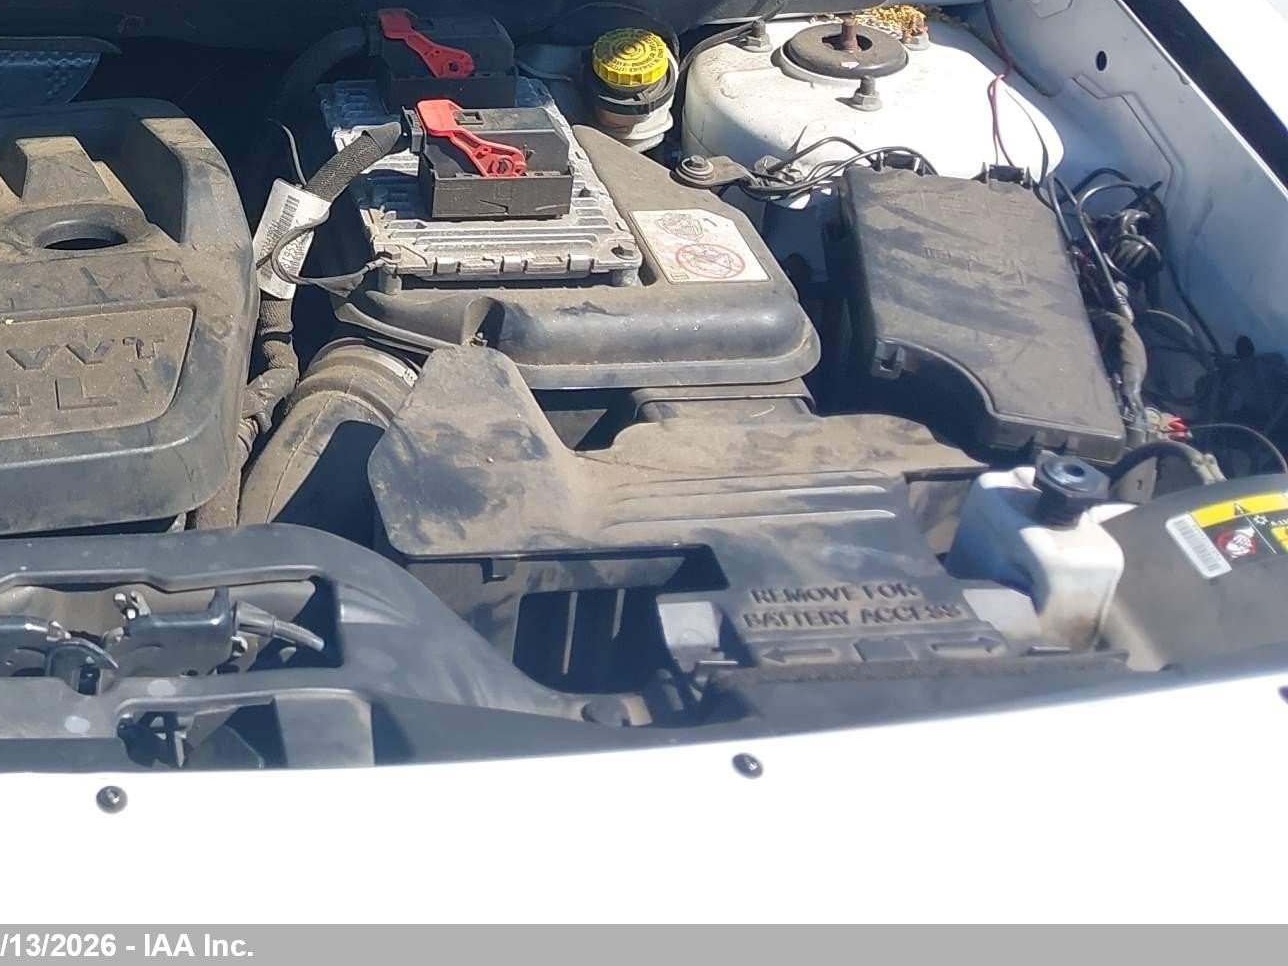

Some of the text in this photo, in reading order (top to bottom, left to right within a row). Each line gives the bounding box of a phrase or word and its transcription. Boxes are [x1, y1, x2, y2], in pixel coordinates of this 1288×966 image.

[750, 583, 919, 604] REMOVE FOR
[743, 603, 962, 628] BATTERY ACCESS
